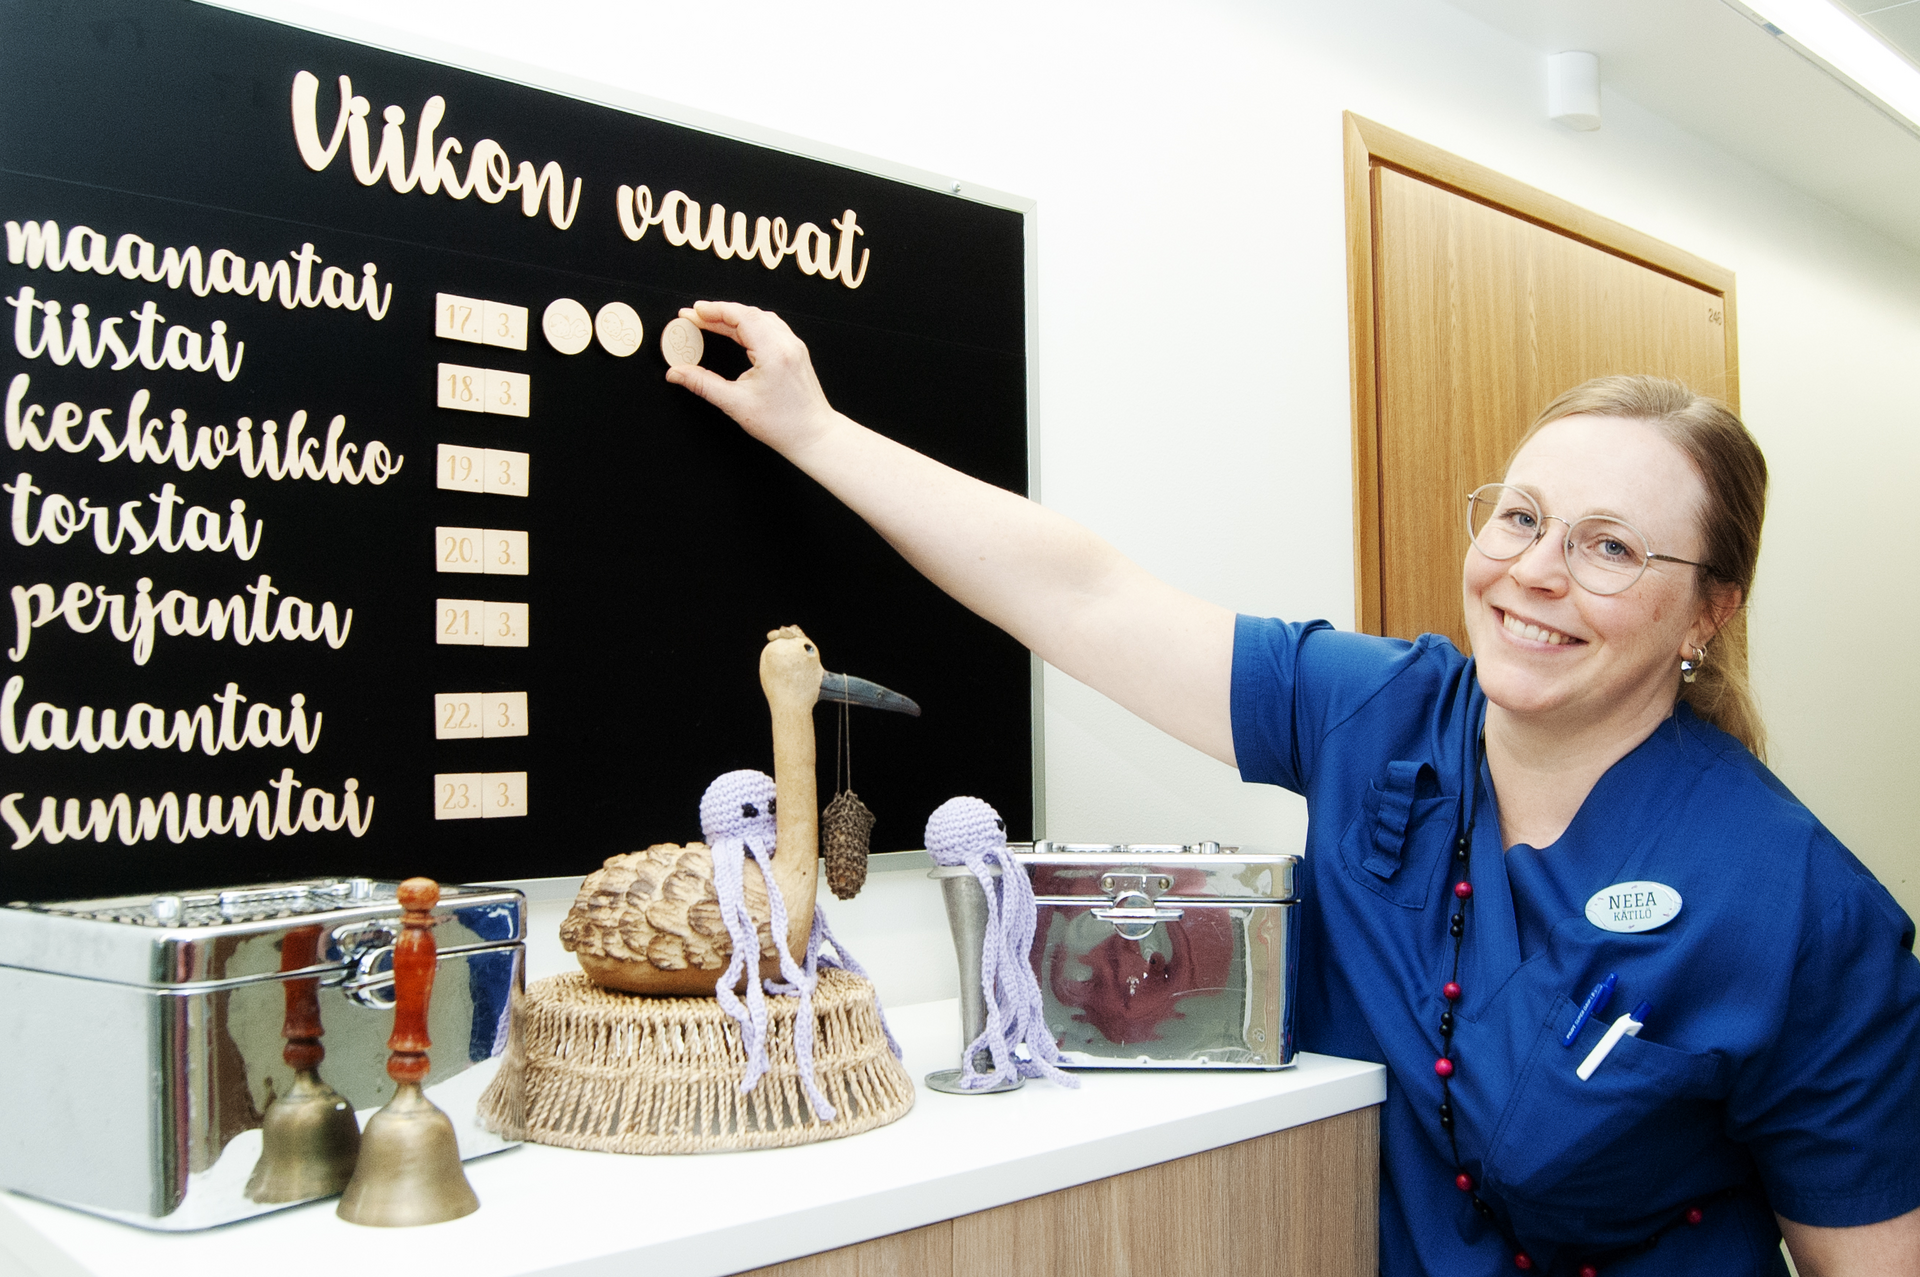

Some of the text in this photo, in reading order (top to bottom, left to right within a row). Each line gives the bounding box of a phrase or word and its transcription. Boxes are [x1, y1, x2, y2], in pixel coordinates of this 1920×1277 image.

[291, 70, 869, 289] Viikon vauvat
[4, 220, 392, 320] maanantai
[5, 286, 244, 381] tiistai
[445, 303, 515, 339] 17. 3.
[446, 373, 517, 407] 18. 3.
[5, 373, 404, 485] keskiviikko
[446, 454, 516, 486] 19. 3.
[3, 473, 263, 560] torstai
[444, 535, 516, 566] 20. 3.
[444, 608, 516, 637] 21. 3.
[0, 676, 322, 756] lauantai
[443, 701, 516, 730] 22. 3.
[0, 768, 374, 850] sunnuntai
[442, 782, 515, 811] 23. 3.
[1608, 892, 1657, 910] NEEA
[1613, 908, 1652, 921] KÄTILÖ
